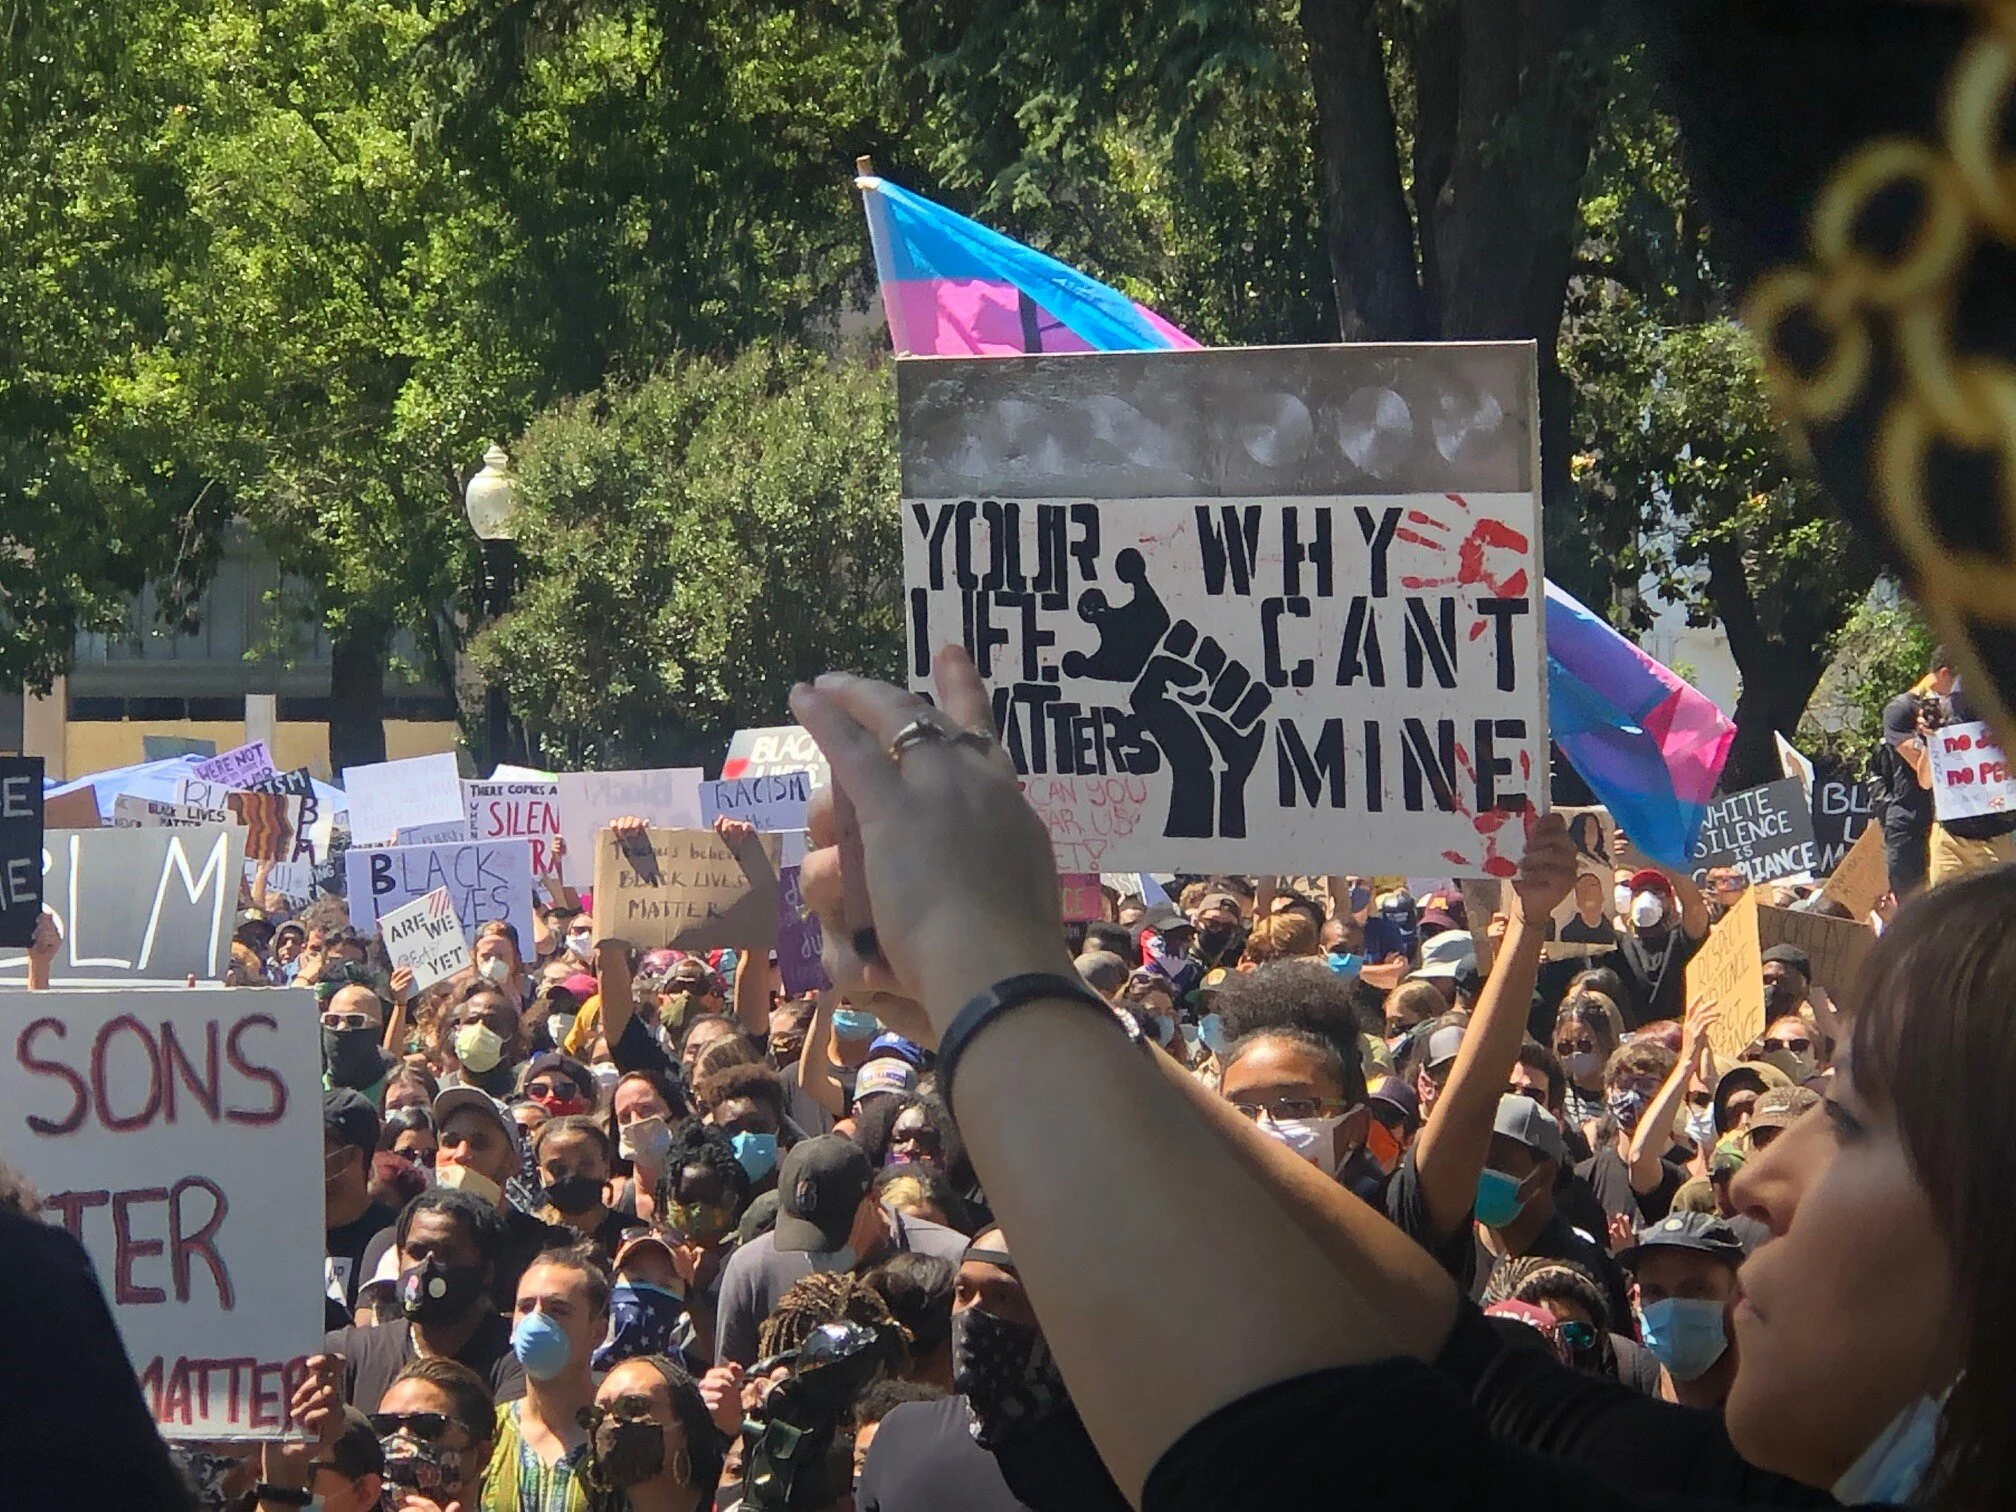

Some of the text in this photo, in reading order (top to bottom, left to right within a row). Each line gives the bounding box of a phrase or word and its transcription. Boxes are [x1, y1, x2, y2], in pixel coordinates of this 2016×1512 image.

[912, 501, 1100, 592] YOUR
[1195, 505, 1403, 598] WHY
[914, 683, 1160, 775] ATTERS
[234, 743, 263, 767] NOT
[1277, 718, 1529, 813] MINE
[470, 784, 558, 798] THERE COMES A
[715, 776, 806, 809] RACISM
[1029, 776, 1147, 807] CAN YOU
[488, 801, 560, 837] SILEN
[1733, 844, 1754, 861] IS
[370, 846, 509, 895] BLACK
[694, 871, 746, 889] LIVES
[0, 832, 228, 978] LM
[628, 899, 723, 919] MATTER
[391, 912, 426, 943] ARE
[422, 914, 454, 940] WE
[427, 946, 462, 976] YET
[16, 1013, 290, 1136] SONS
[43, 1175, 236, 1311] TER
